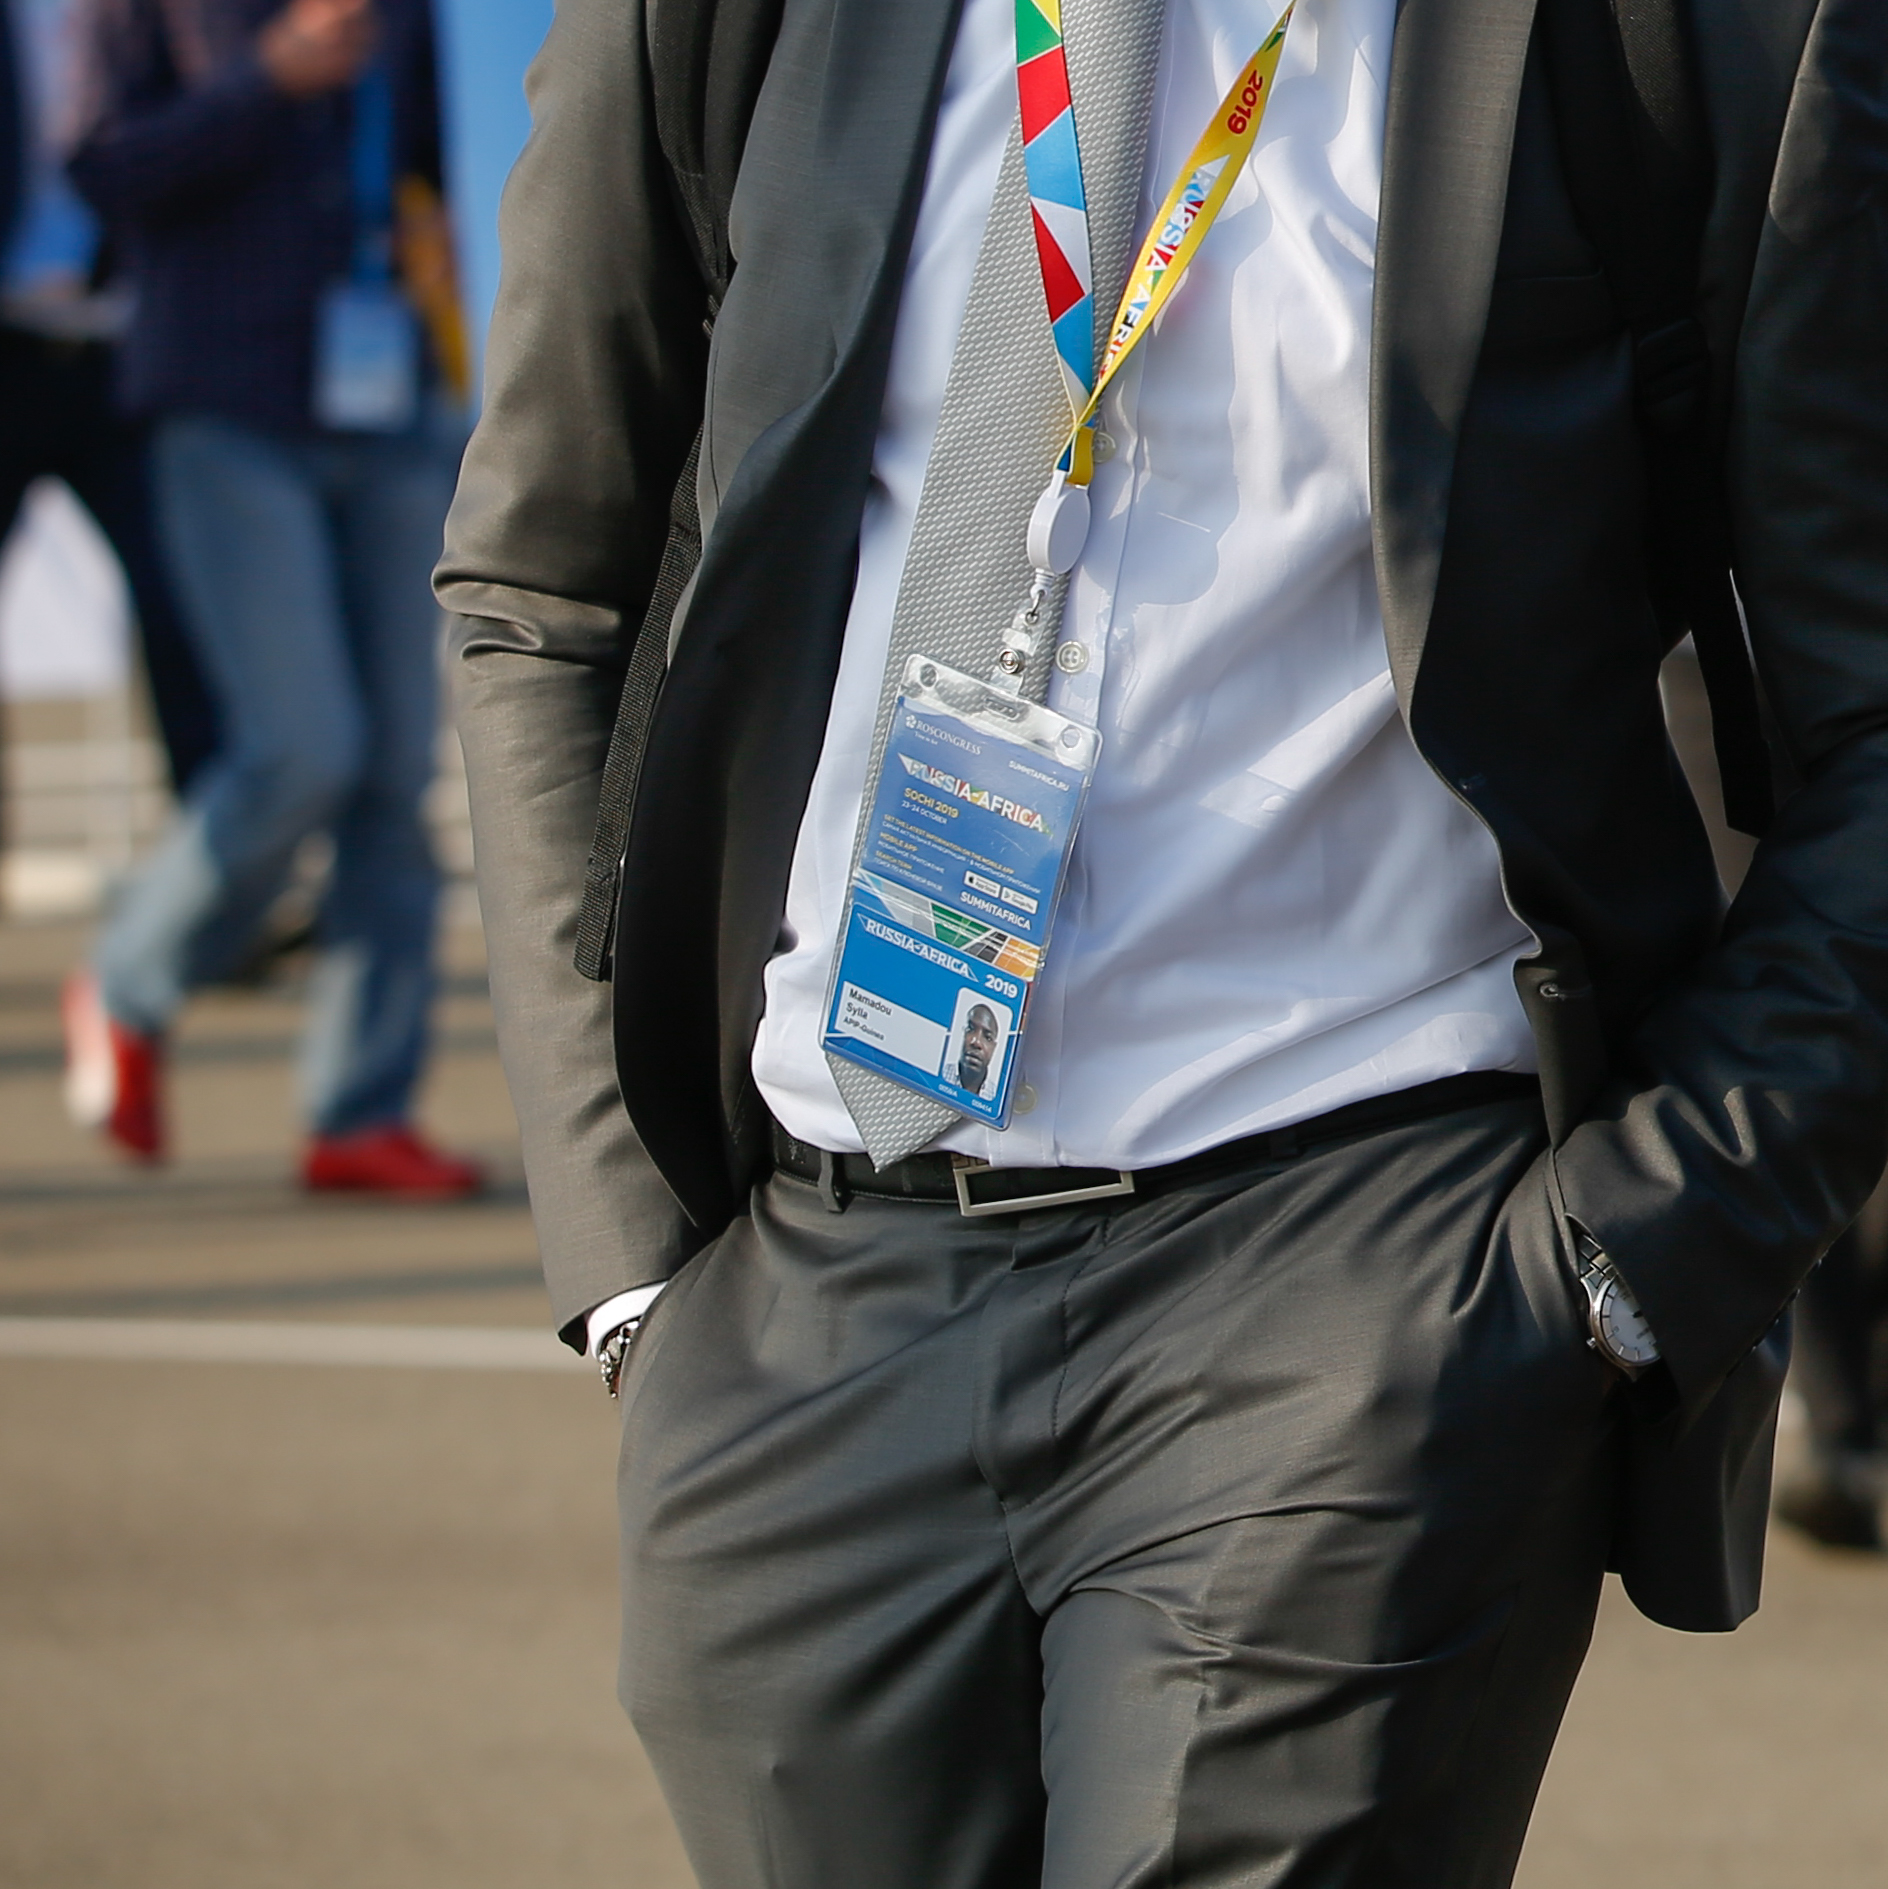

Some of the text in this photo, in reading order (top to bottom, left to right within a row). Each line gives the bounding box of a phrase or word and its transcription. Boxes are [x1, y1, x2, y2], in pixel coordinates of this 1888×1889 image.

[1226, 68, 1264, 136] 2019
[1099, 170, 1219, 384] RUSSIA-AFRIC
[916, 720, 981, 756] ROSCONGRESS
[903, 786, 959, 819] SOCHI 2019
[908, 759, 1045, 832] RUSSIA-AFRICA
[960, 890, 1032, 930] SUMMITAFRICA
[864, 918, 1019, 1000] RUSSIA-AFRICA 2019
[845, 1000, 868, 1020] Sylla
[848, 988, 892, 1015] Mamadou
